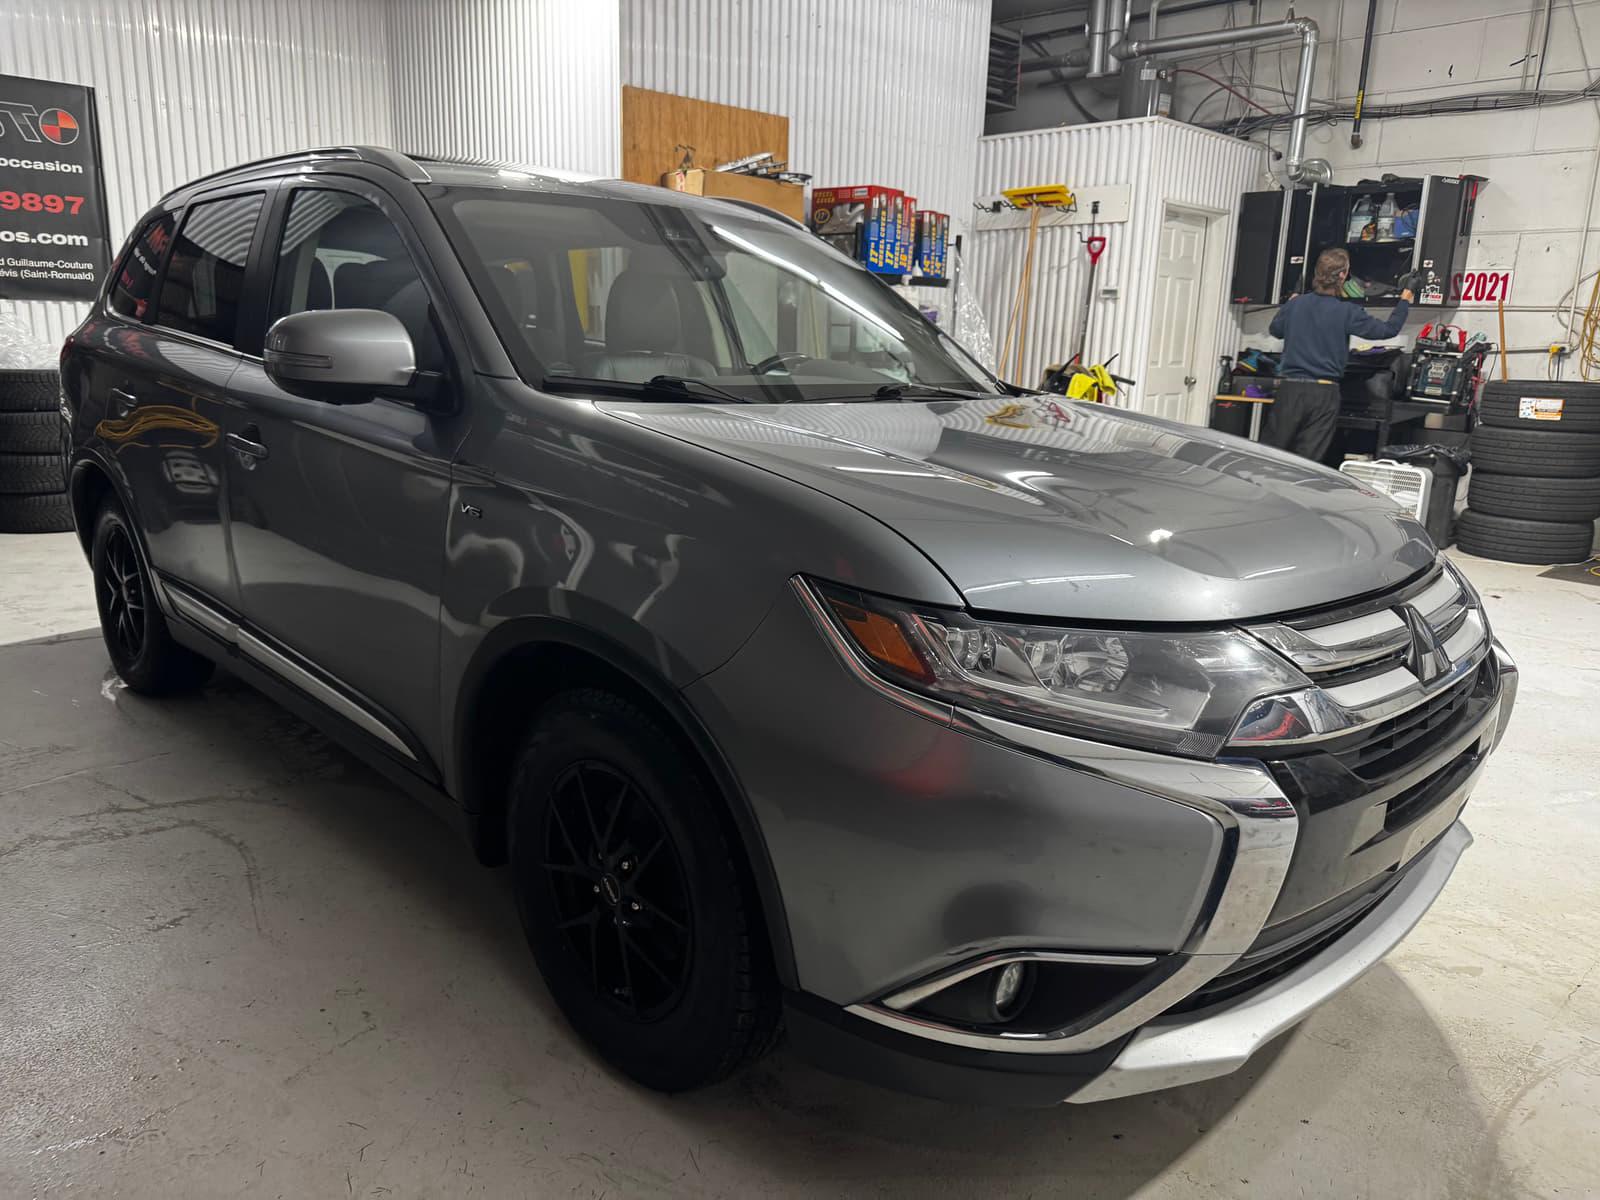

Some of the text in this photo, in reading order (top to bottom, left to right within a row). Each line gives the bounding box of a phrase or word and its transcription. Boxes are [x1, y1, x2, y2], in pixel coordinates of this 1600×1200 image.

[0, 157, 83, 174] occasion
[0, 190, 85, 215] 9897
[0, 230, 89, 247] os.com
[6, 257, 94, 270] Guillaume-Couture
[20, 269, 95, 282] (Saint-Romuald)
